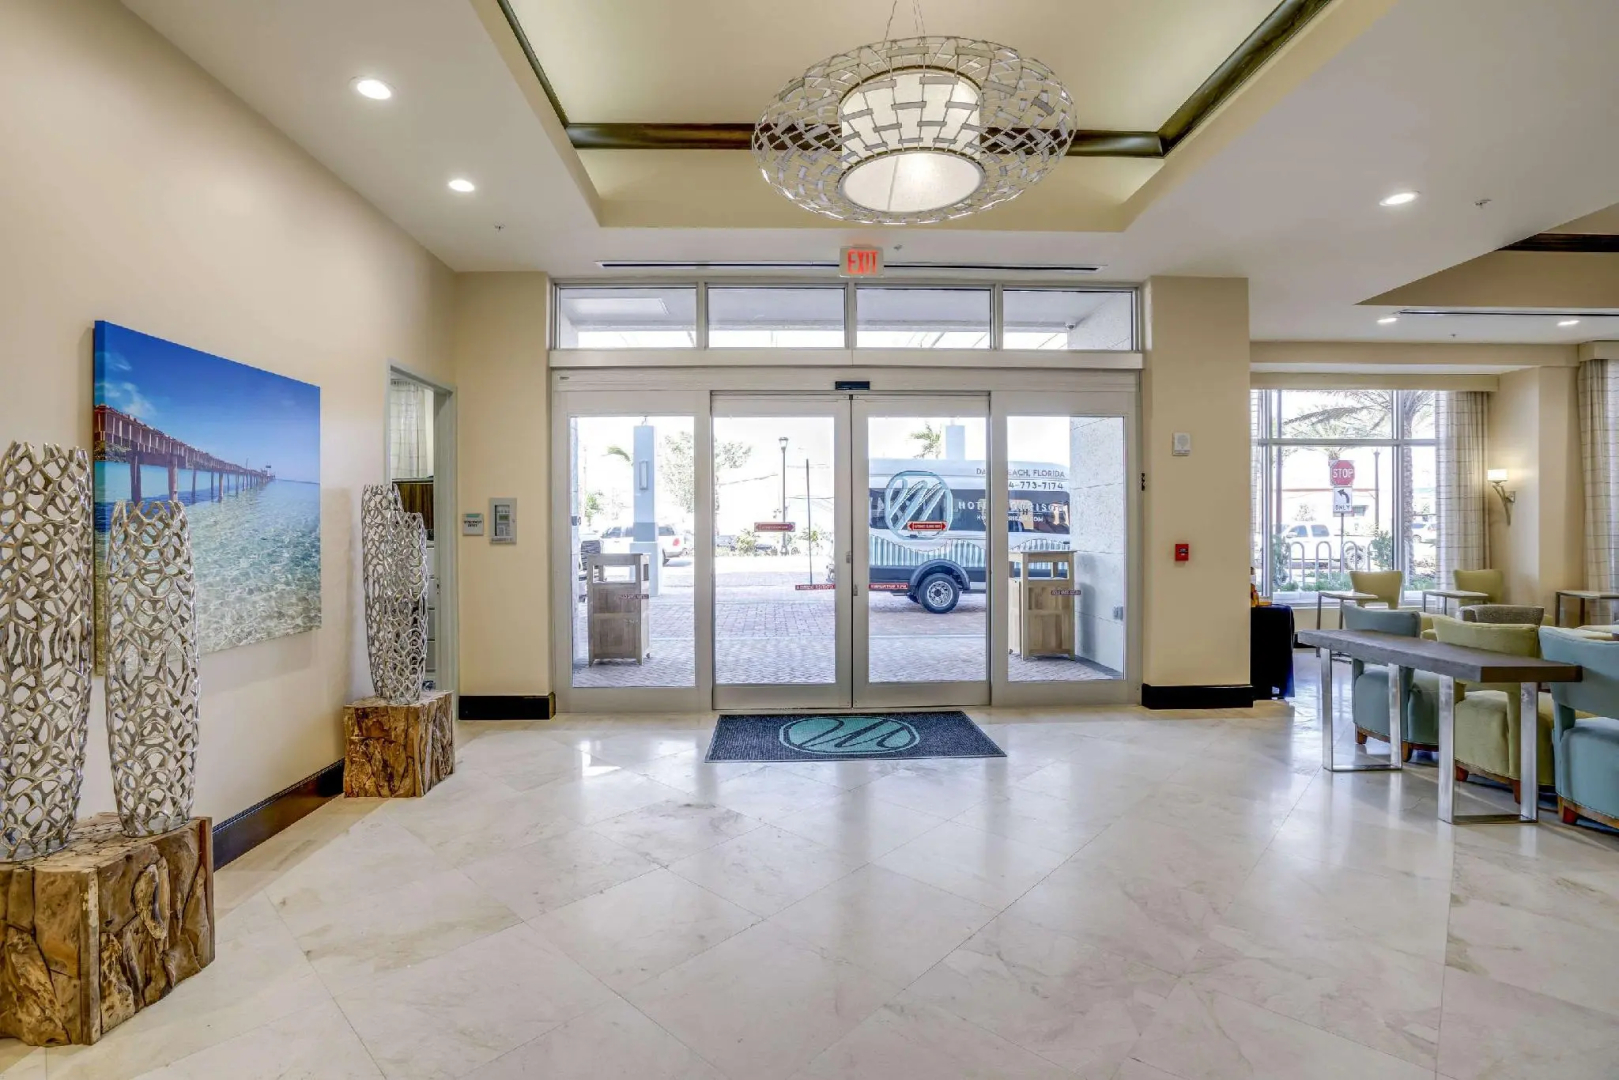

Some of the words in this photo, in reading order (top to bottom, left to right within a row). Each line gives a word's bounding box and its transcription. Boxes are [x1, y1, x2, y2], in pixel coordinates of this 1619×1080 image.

[847, 249, 879, 274] EXIT
[1007, 469, 1031, 477] EACH,
[1032, 469, 1065, 478] FLORIDA
[1332, 468, 1354, 479] STOP
[1008, 481, 1064, 489] 4-773-7174
[958, 501, 986, 511] HOT
